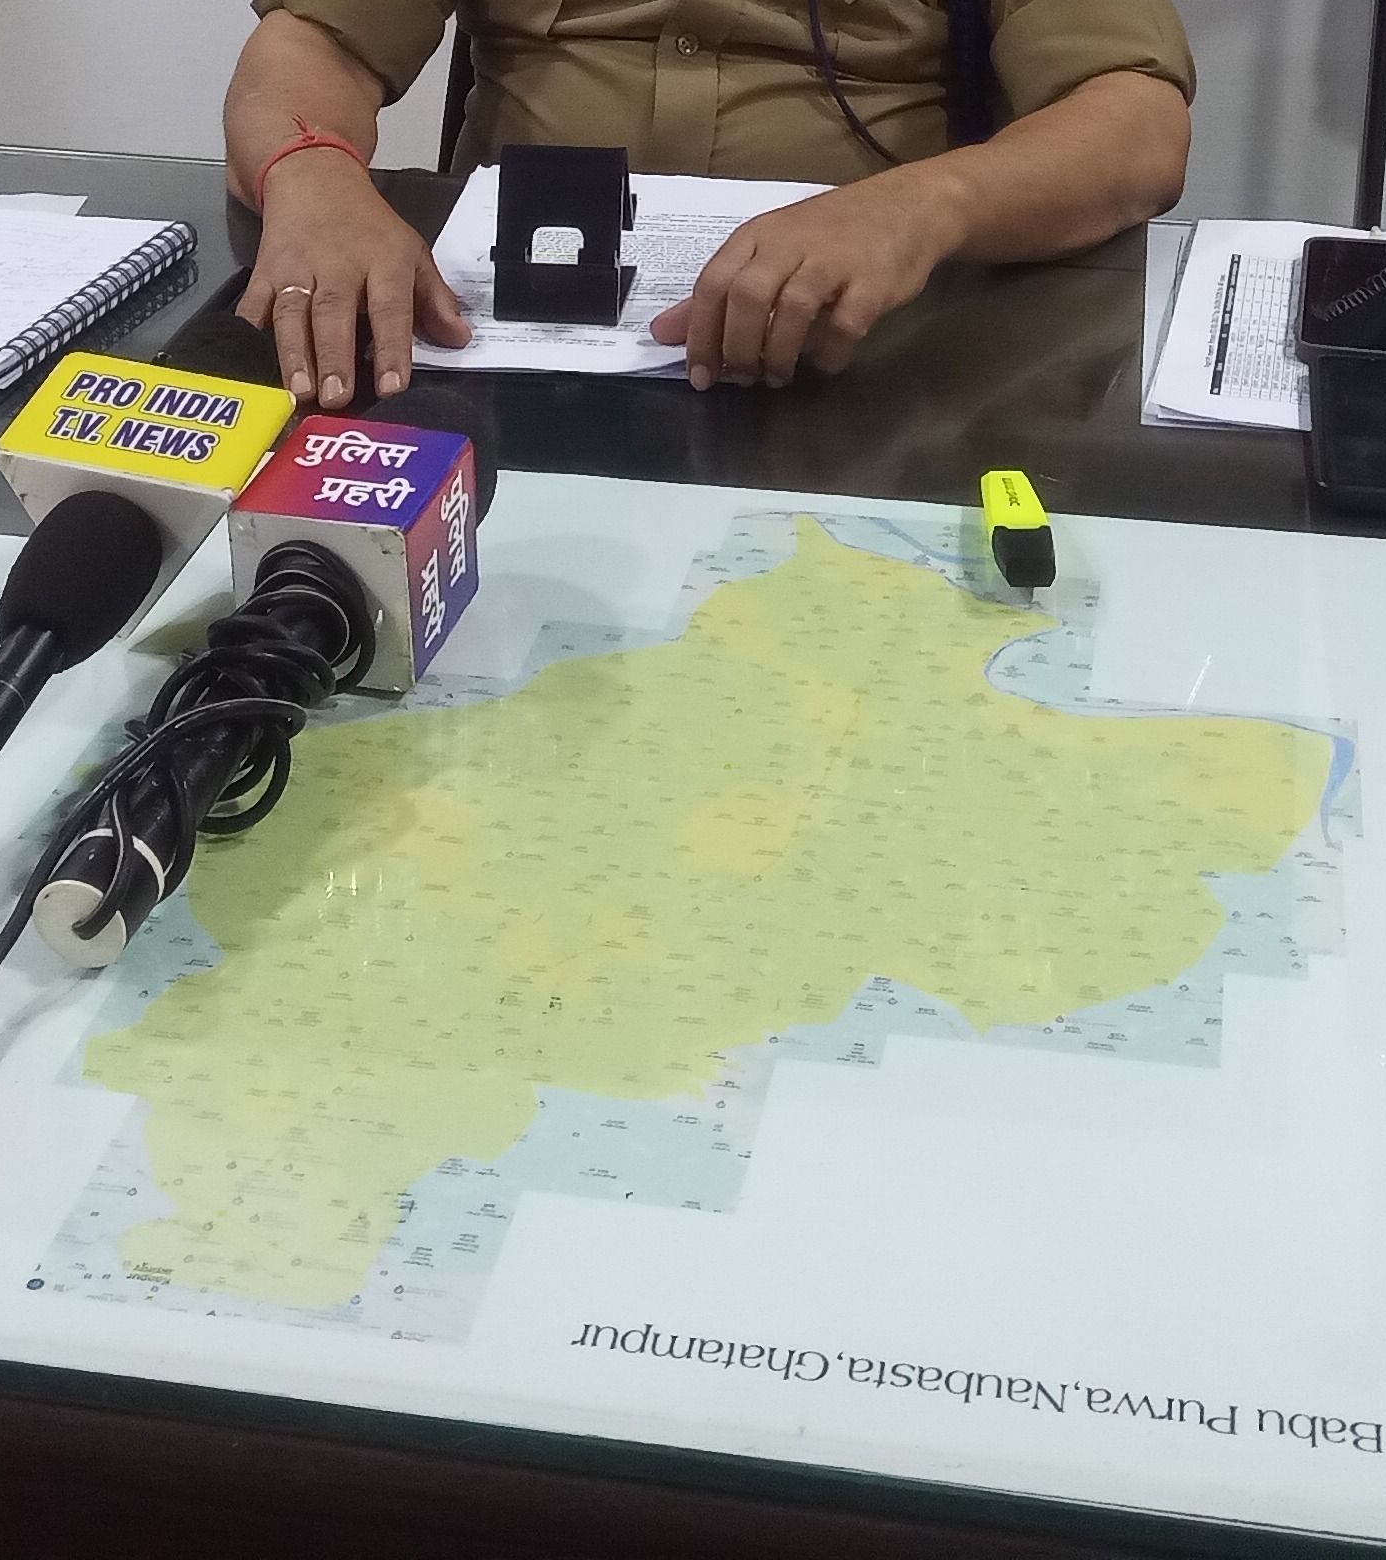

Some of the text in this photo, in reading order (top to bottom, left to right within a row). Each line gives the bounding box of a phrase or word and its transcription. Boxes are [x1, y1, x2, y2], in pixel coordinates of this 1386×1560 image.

[63, 371, 244, 427] PRO INDIA
[47, 407, 218, 462] T.V. NEWS
[295, 429, 419, 469] पुलिस
[313, 474, 416, 511] प्रहरी
[440, 469, 469, 588] पुलिस
[420, 548, 446, 649] प्रहरी
[1256, 1408, 1384, 1454] Babu
